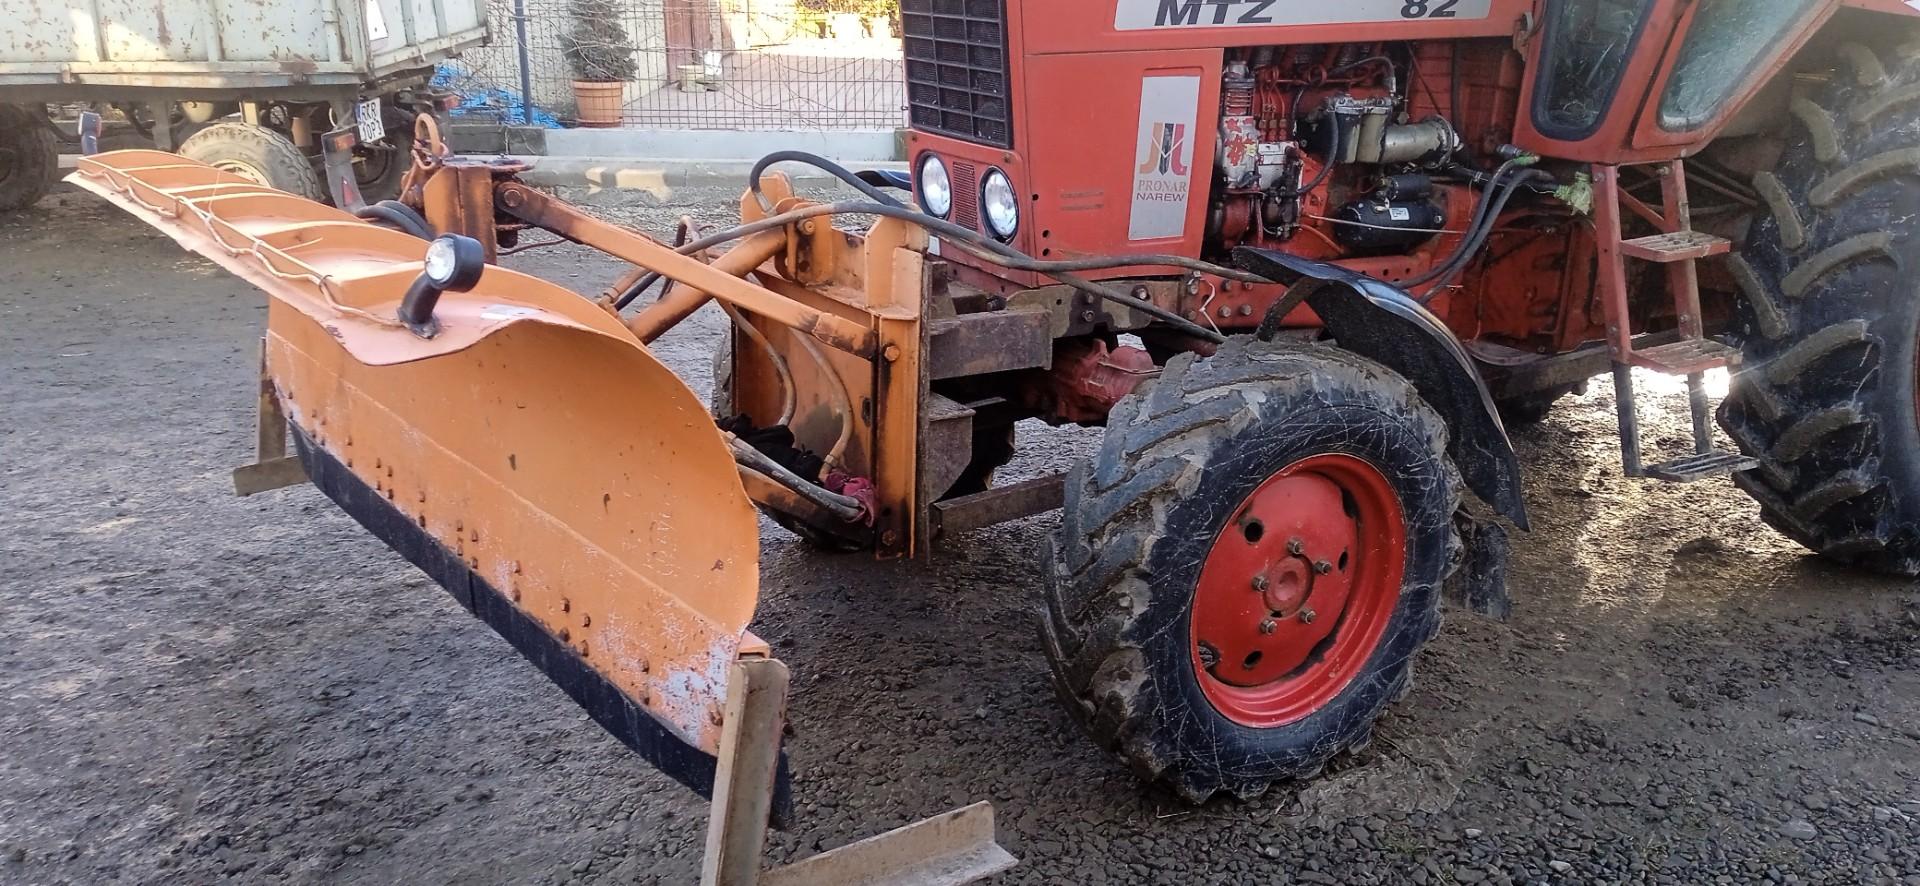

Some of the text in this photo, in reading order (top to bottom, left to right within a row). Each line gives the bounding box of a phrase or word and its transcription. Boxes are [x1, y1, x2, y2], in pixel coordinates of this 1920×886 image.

[1154, 0, 1457, 26] MTZ 82
[1138, 180, 1187, 192] PRONAR
[1136, 192, 1185, 201] NAREW
